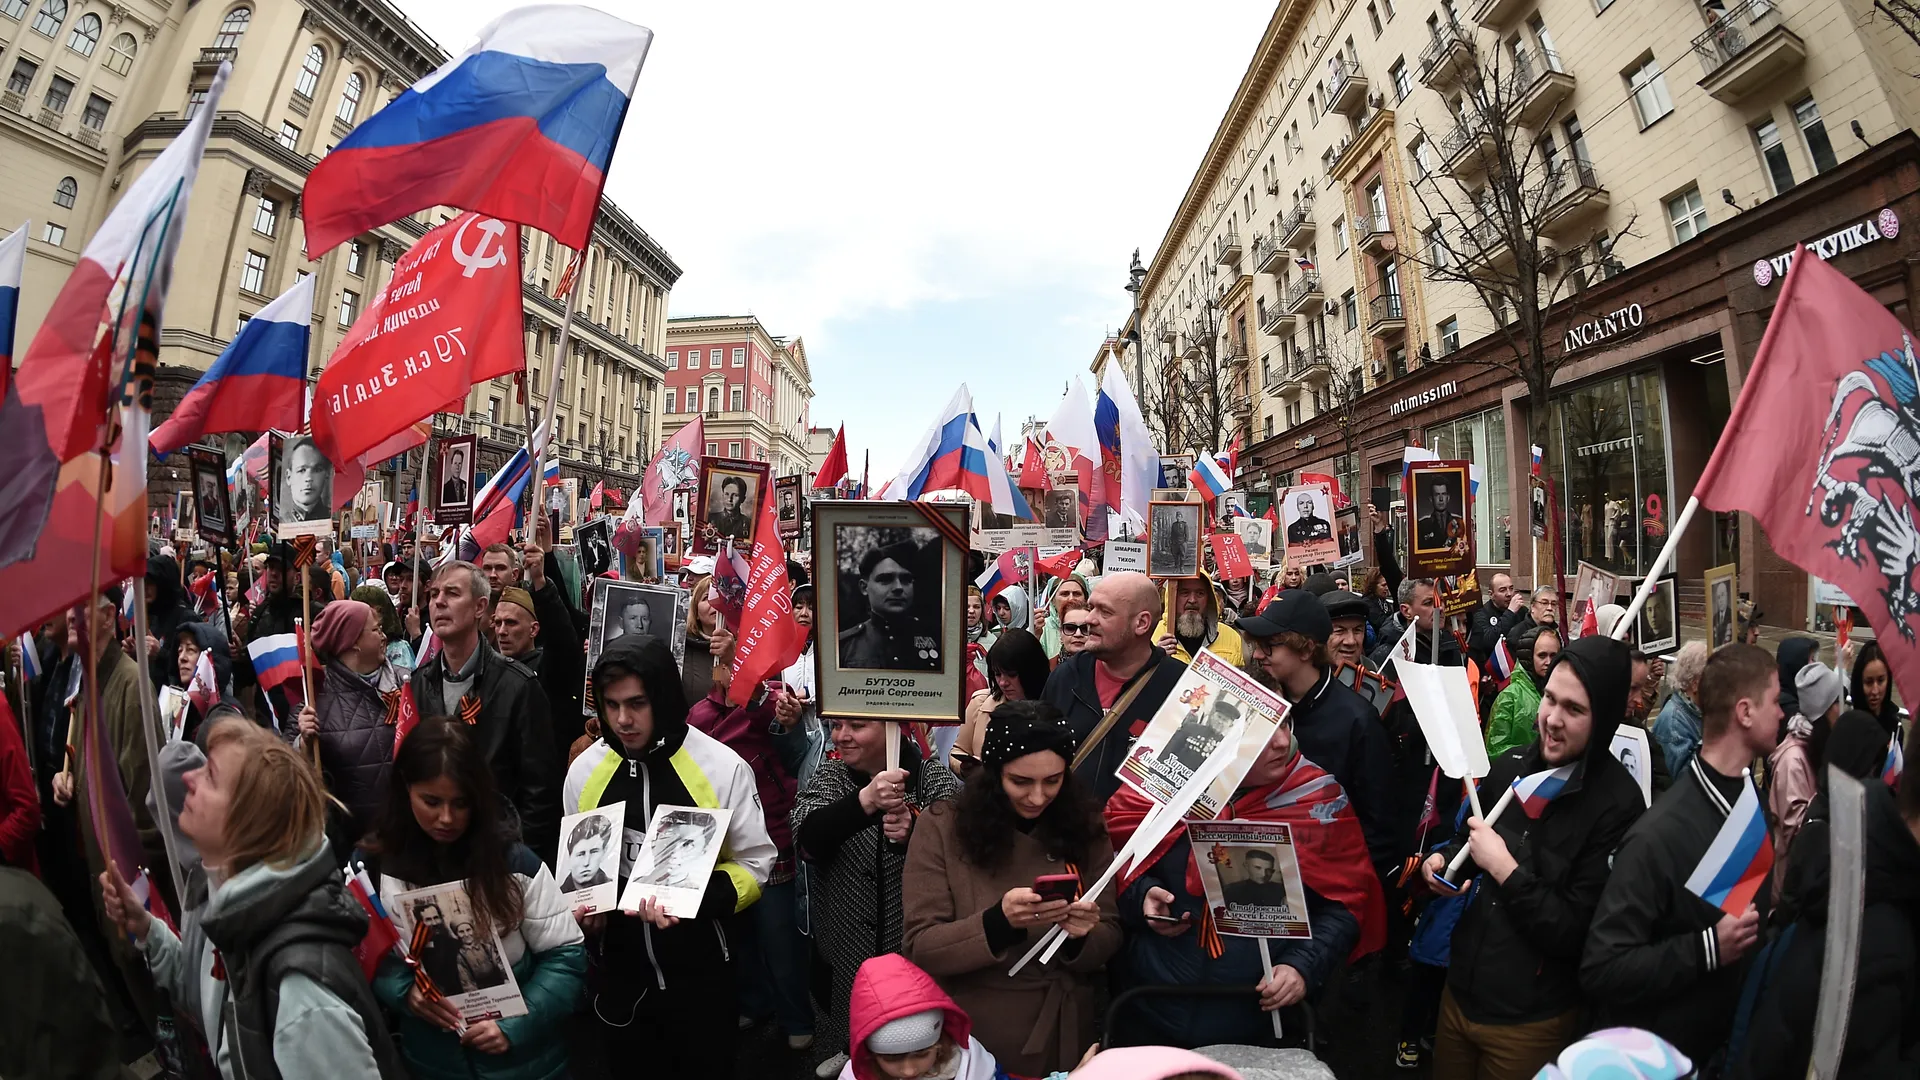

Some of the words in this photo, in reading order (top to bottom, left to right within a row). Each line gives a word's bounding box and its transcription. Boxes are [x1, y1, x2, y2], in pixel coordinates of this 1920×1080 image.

[1770, 250, 1797, 277] VI
[1564, 303, 1644, 353] INCANTO
[1390, 380, 1457, 416] intimissimi
[1646, 493, 1662, 520] 9
[838, 687, 885, 698] Дмитрий
[888, 688, 942, 698] Сергеевич
[866, 678, 916, 686] БУТУЗОВ
[1199, 663, 1255, 704] Бессмертный
[1138, 751, 1170, 775] Антон
[1141, 780, 1170, 803] Участни
[1199, 832, 1260, 841] Бессмертный
[1224, 910, 1258, 919] Алексей
[1260, 912, 1298, 920] Егорович
